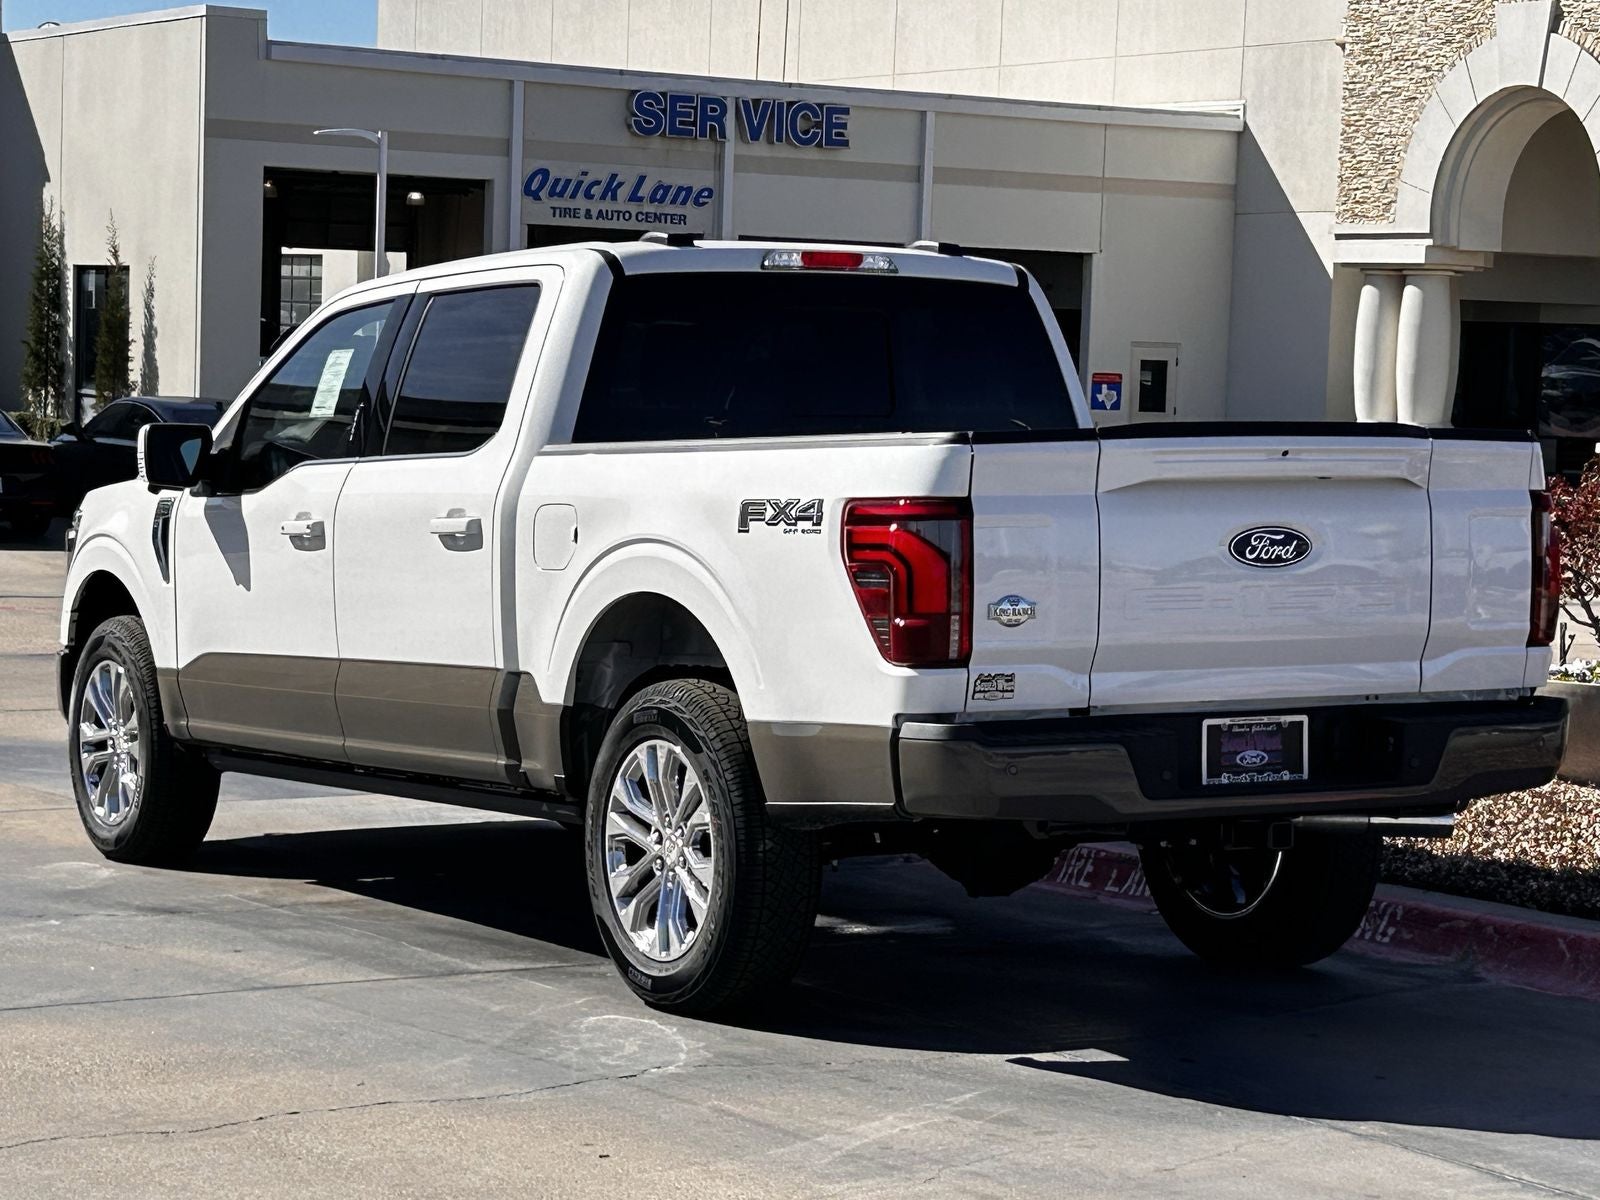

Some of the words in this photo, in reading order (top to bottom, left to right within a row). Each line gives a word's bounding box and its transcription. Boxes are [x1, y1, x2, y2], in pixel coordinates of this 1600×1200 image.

[630, 89, 850, 148] SERVICE
[523, 167, 625, 203] Quick
[626, 174, 714, 208] Lane
[550, 206, 581, 219] TIRE
[584, 208, 593, 220] &
[596, 209, 632, 222] AUTO
[635, 212, 687, 226] CENTER
[738, 498, 824, 533] FX4
[1245, 533, 1298, 560] Ford
[993, 606, 1011, 617] KING
